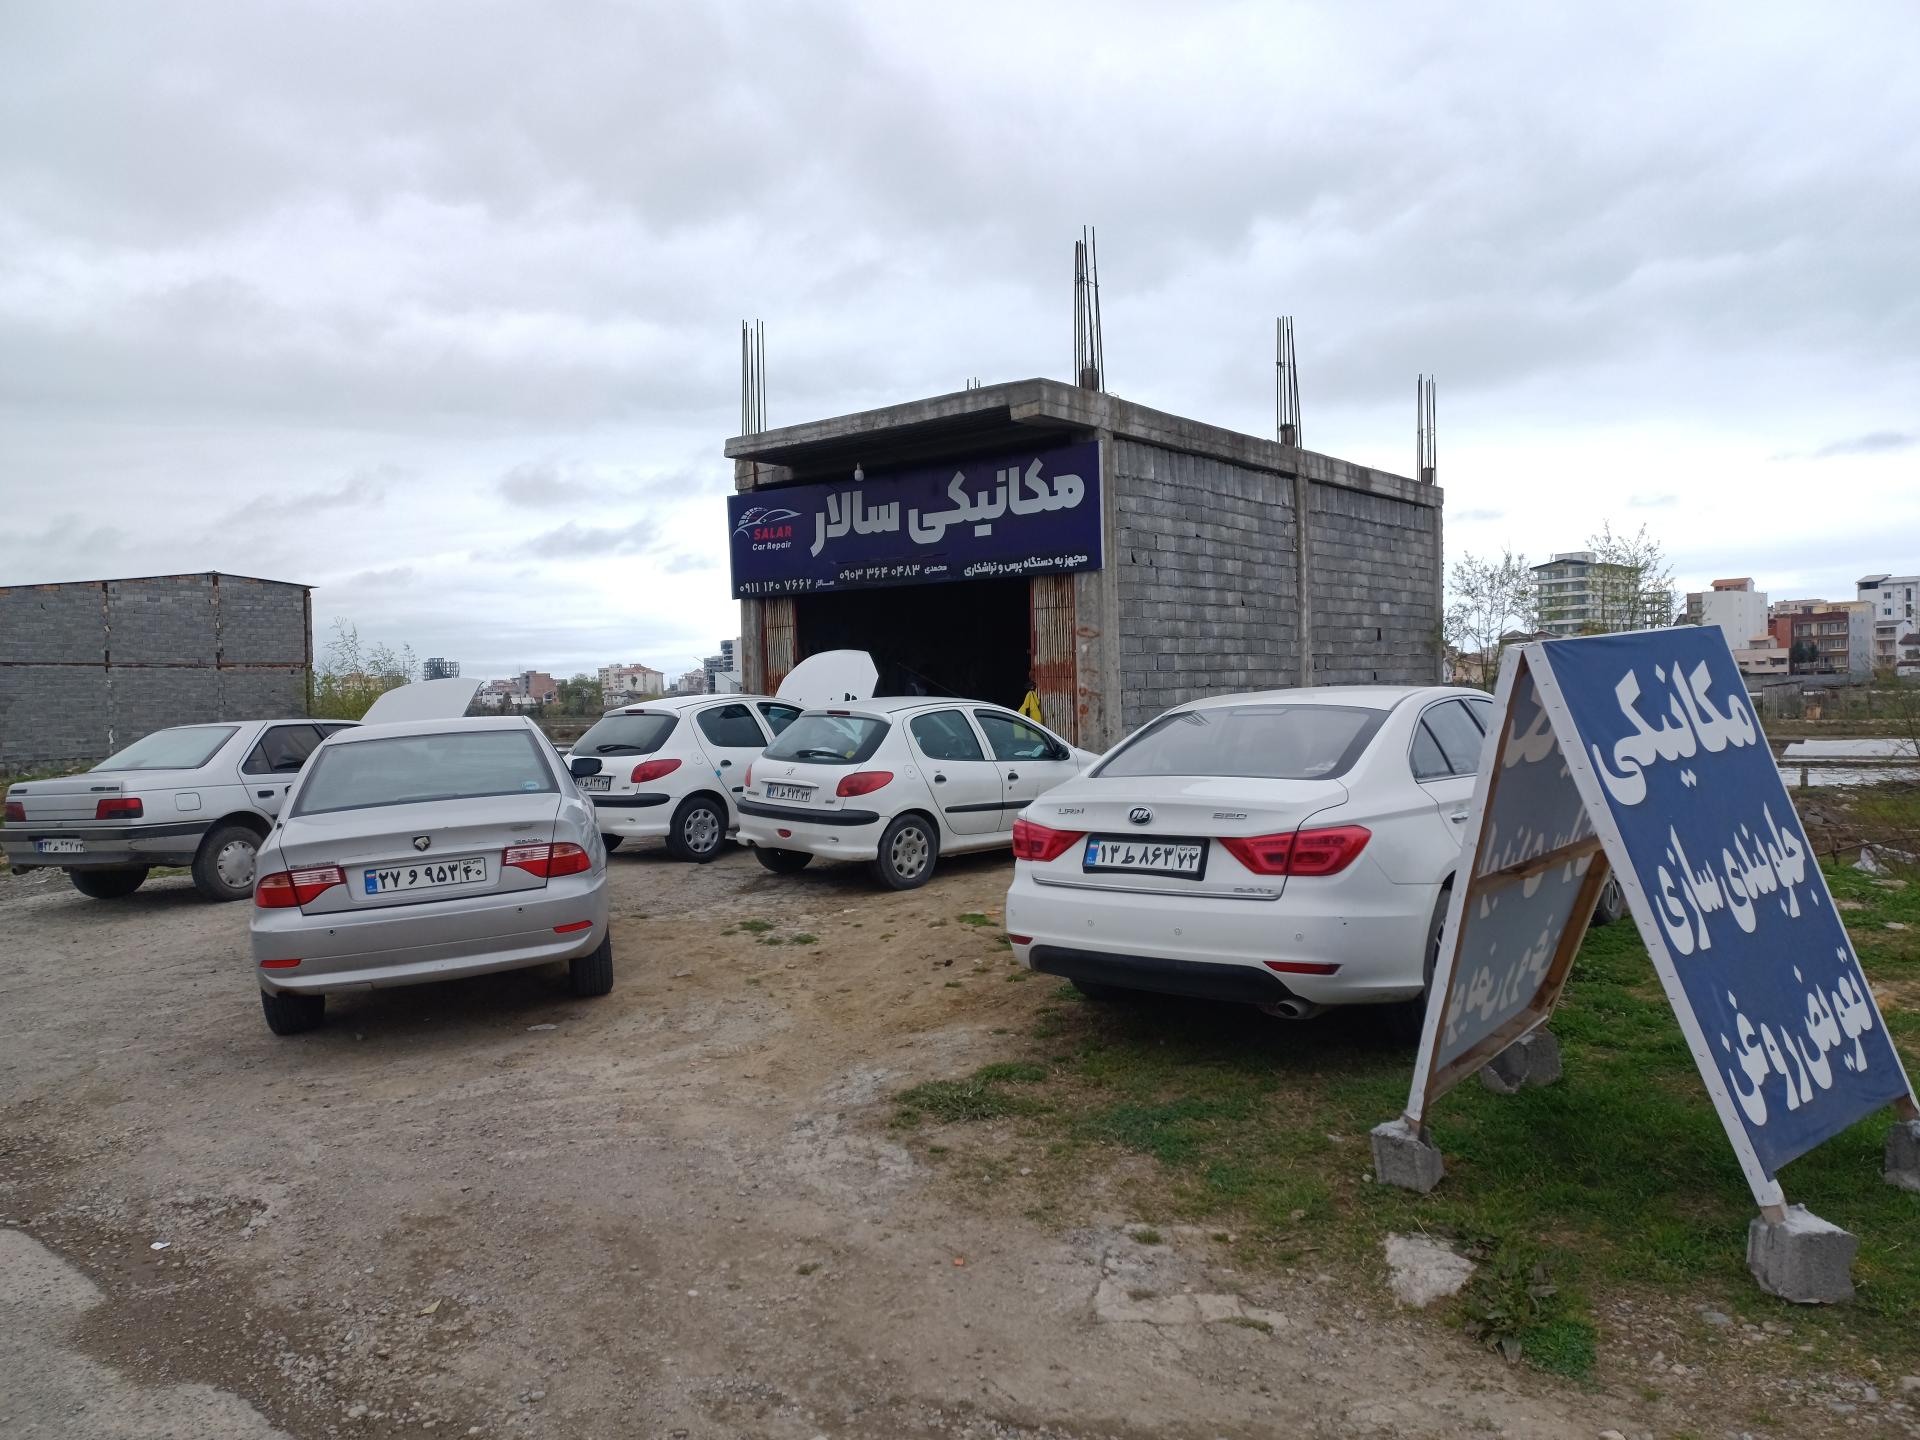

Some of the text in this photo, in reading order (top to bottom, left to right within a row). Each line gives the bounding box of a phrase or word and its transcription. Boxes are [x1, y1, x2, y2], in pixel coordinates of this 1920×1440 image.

[752, 541, 791, 551] Car Repair
[753, 526, 792, 539] SALAR
[810, 458, 1085, 558] مکانیکی سالار
[963, 554, 1088, 577] مجهز به دستگاه پرس و تراشکاری
[1592, 660, 1757, 806] مکانیکی
[378, 870, 401, 889] ۲۷
[408, 870, 418, 885] و
[425, 863, 458, 883] ۹۵۳
[1655, 824, 1724, 956] سازی
[1720, 801, 1819, 934] جلوبندی
[1720, 946, 1873, 1127] تعویض روغن
